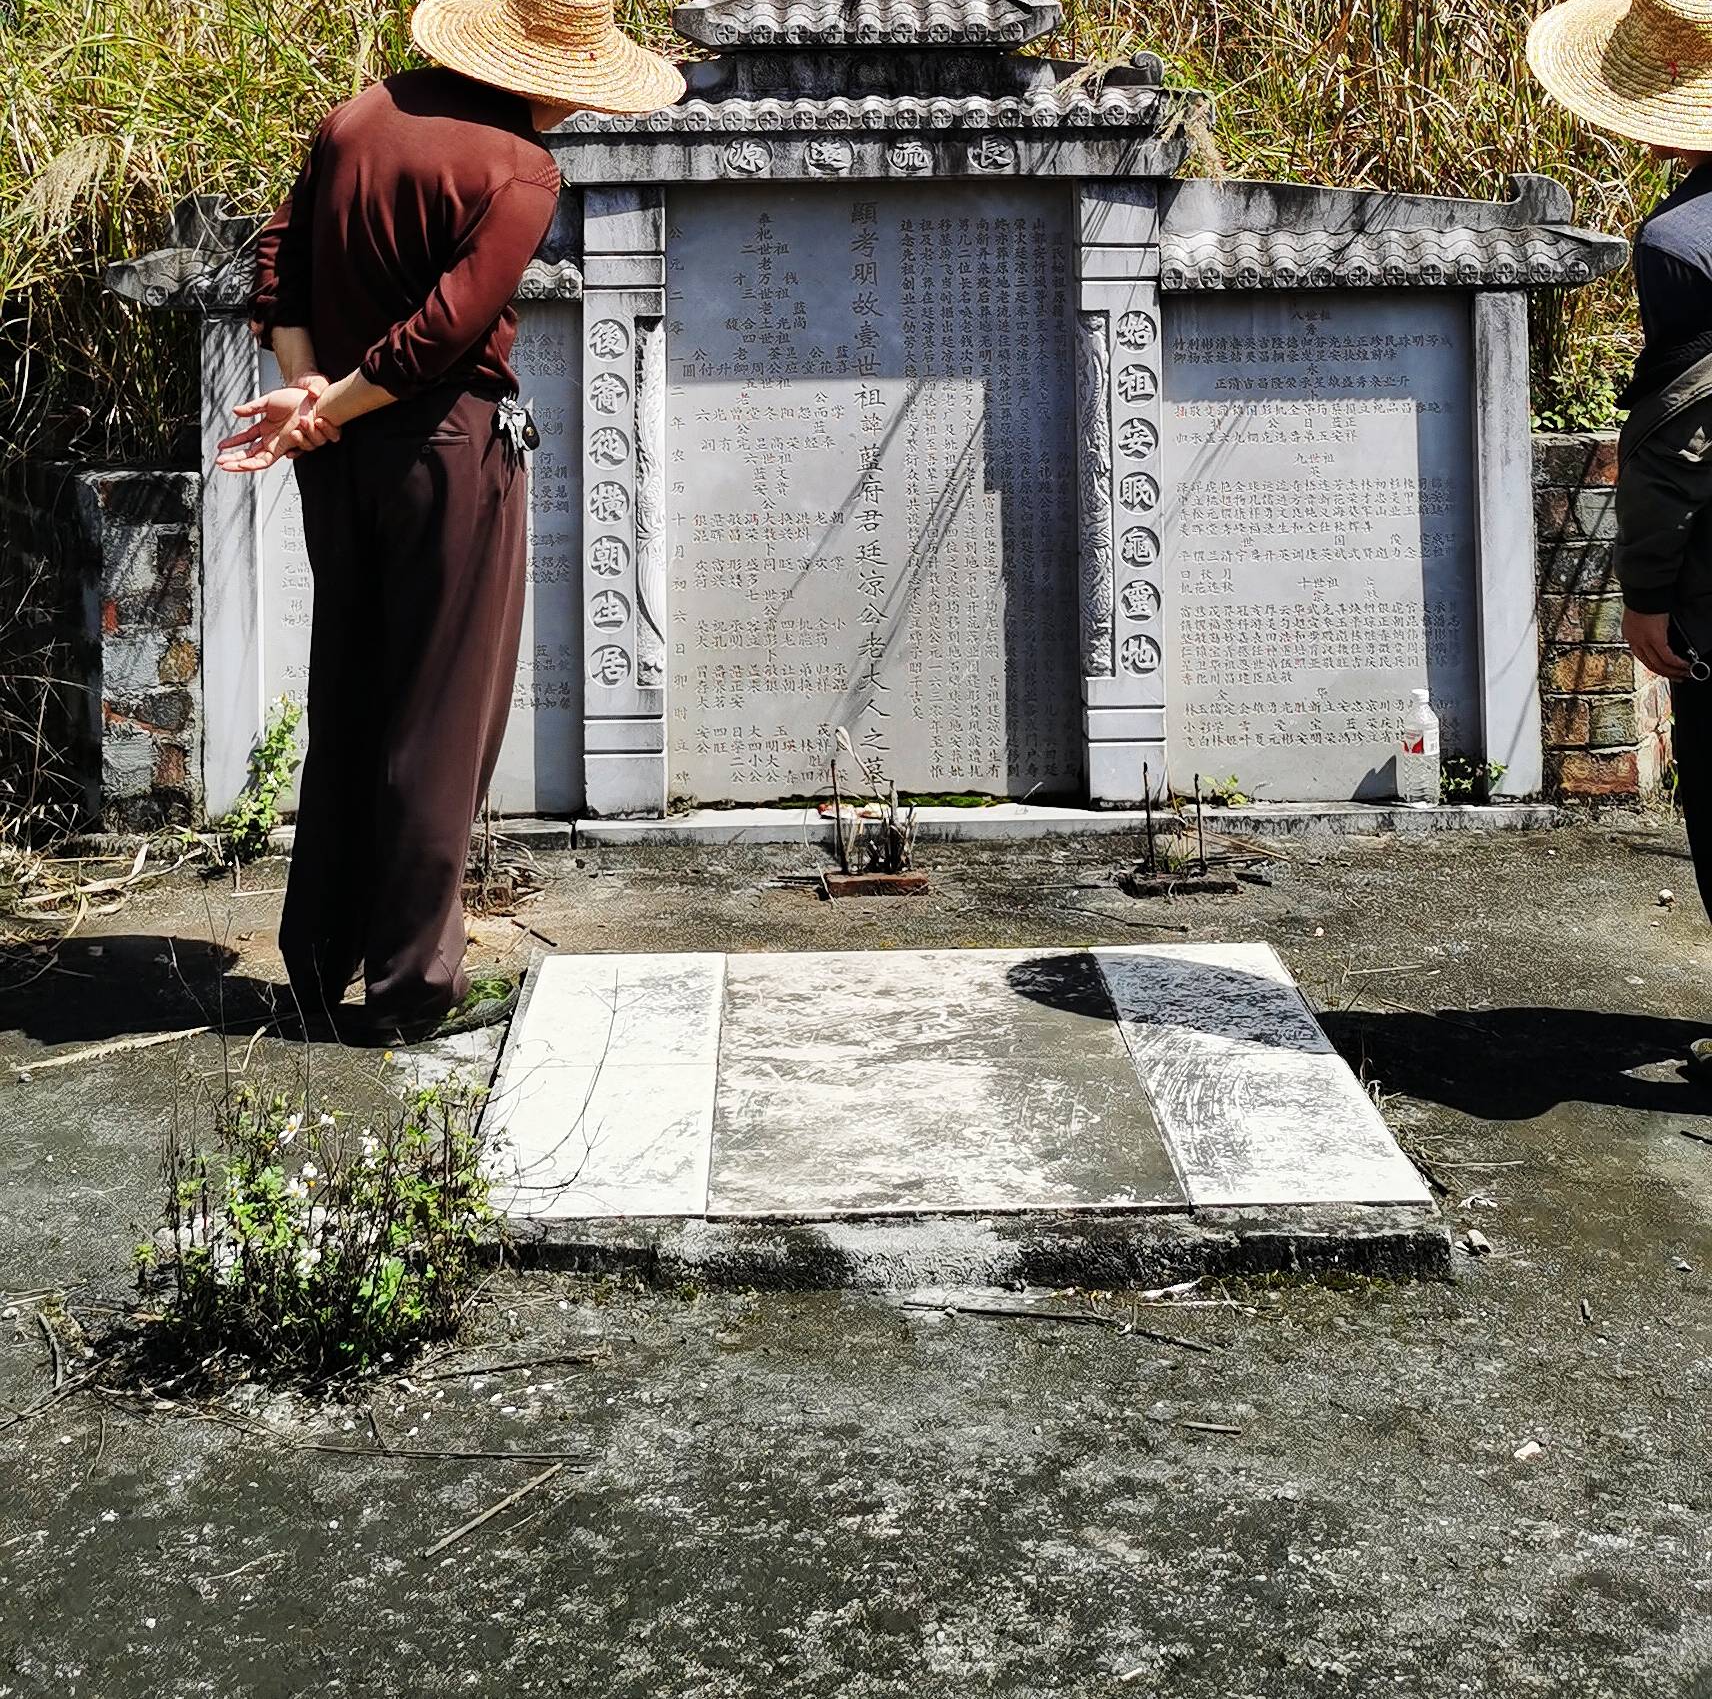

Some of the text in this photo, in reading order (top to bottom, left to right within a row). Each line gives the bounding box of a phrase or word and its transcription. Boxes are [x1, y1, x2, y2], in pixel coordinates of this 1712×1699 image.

[741, 243, 789, 255] 二世祖
[742, 288, 790, 301] 三世祖
[742, 333, 791, 346] 四世祖
[742, 378, 792, 391] 五世祖
[743, 452, 793, 465] 六世祖
[1116, 312, 1160, 676] 始祖安眠龜靈地
